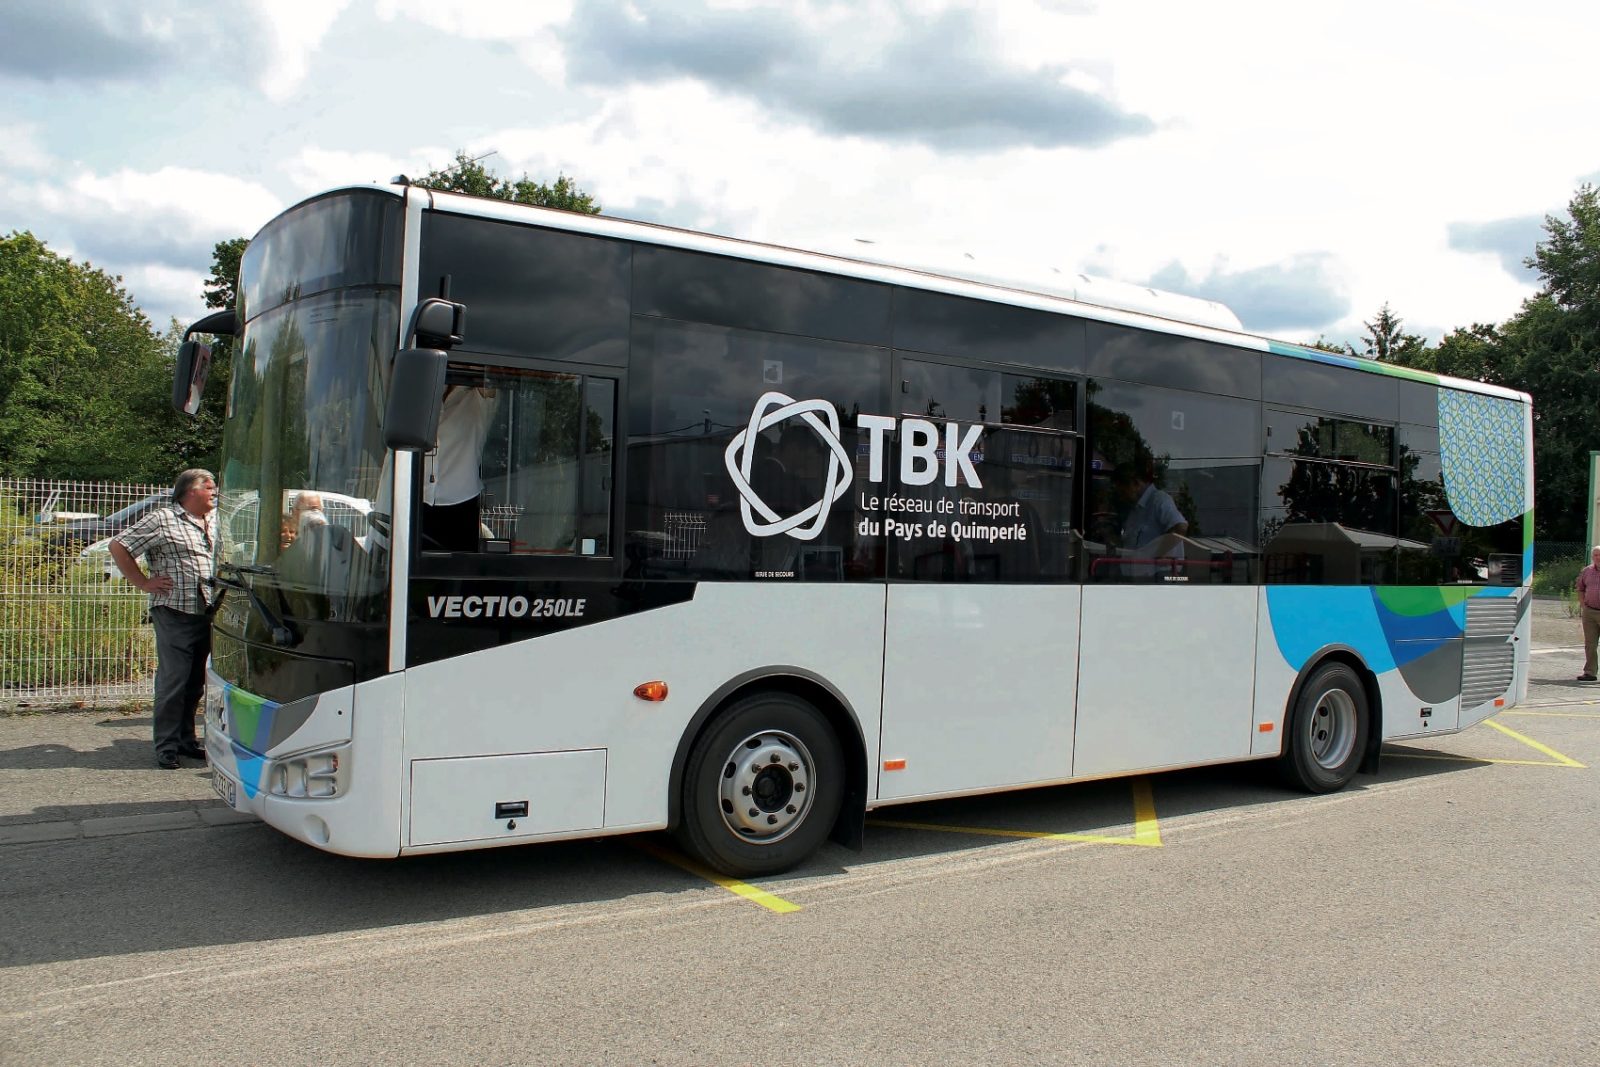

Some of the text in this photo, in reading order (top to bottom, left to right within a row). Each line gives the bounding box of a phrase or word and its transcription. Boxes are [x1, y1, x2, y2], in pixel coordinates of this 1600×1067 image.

[857, 414, 984, 489] TBK
[861, 492, 1020, 519] Le réseau de transport
[858, 517, 1027, 543] du Pays de Quimperlé
[427, 595, 587, 618] VECTIO 250LE
